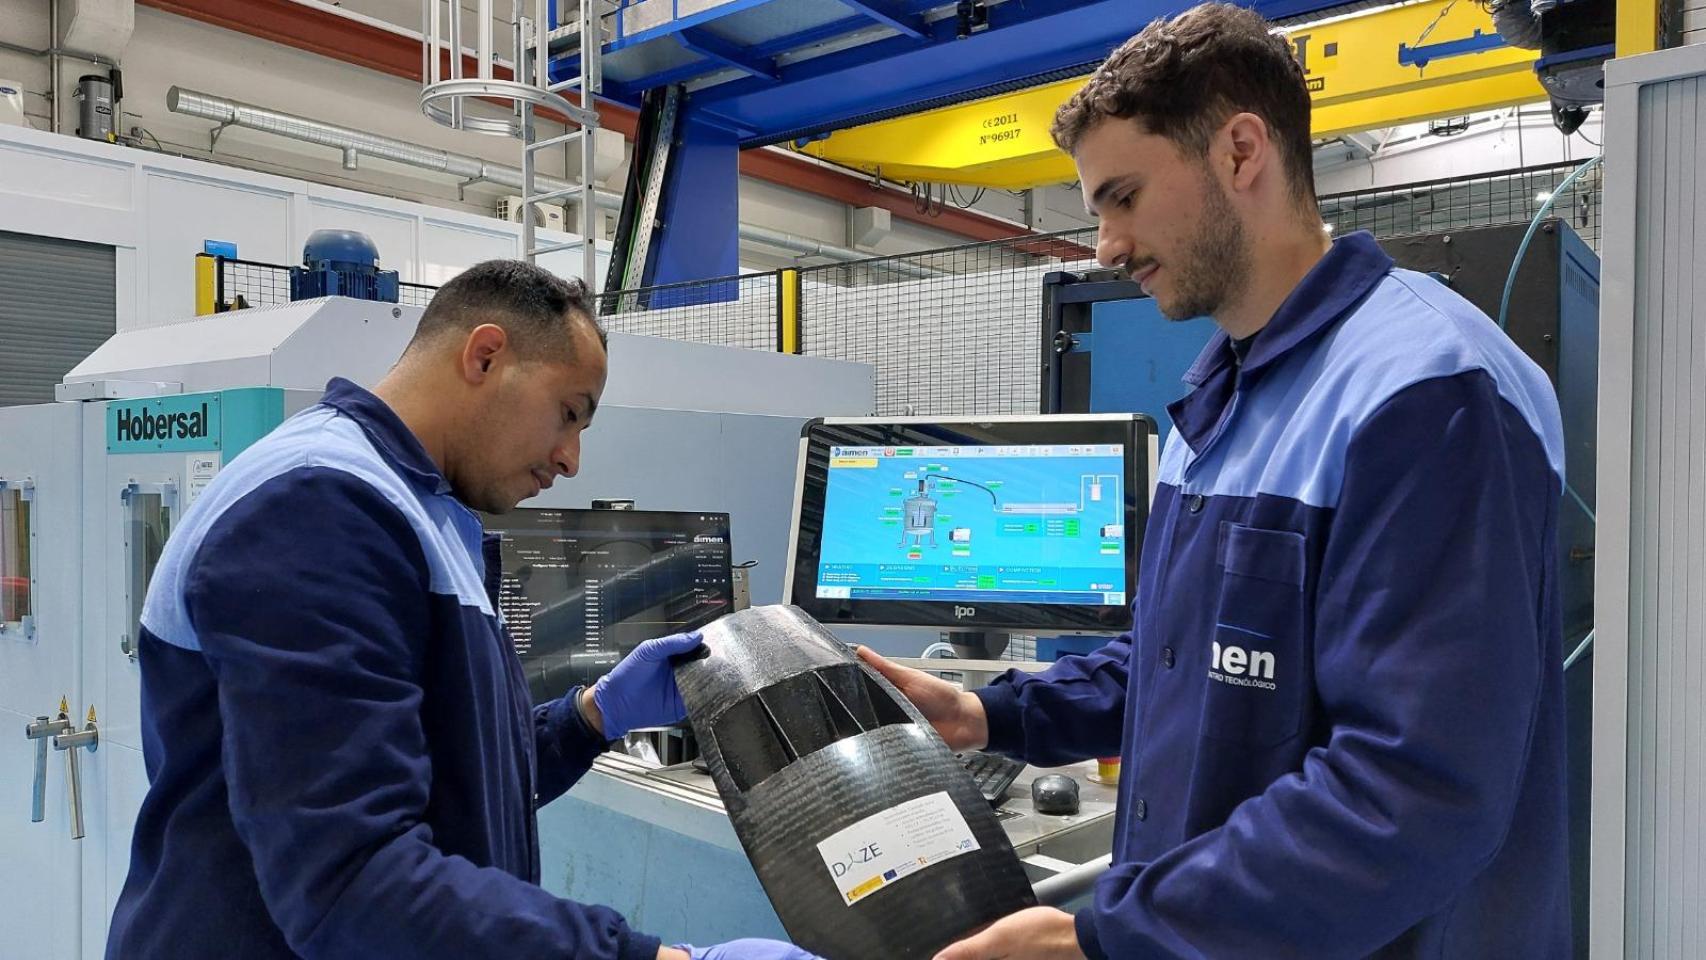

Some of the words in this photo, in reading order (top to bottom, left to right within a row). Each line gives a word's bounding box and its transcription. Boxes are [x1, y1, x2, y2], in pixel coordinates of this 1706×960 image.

[994, 113, 1017, 126] 2011
[117, 402, 208, 441] Hobersal
[954, 605, 975, 619] ipo
